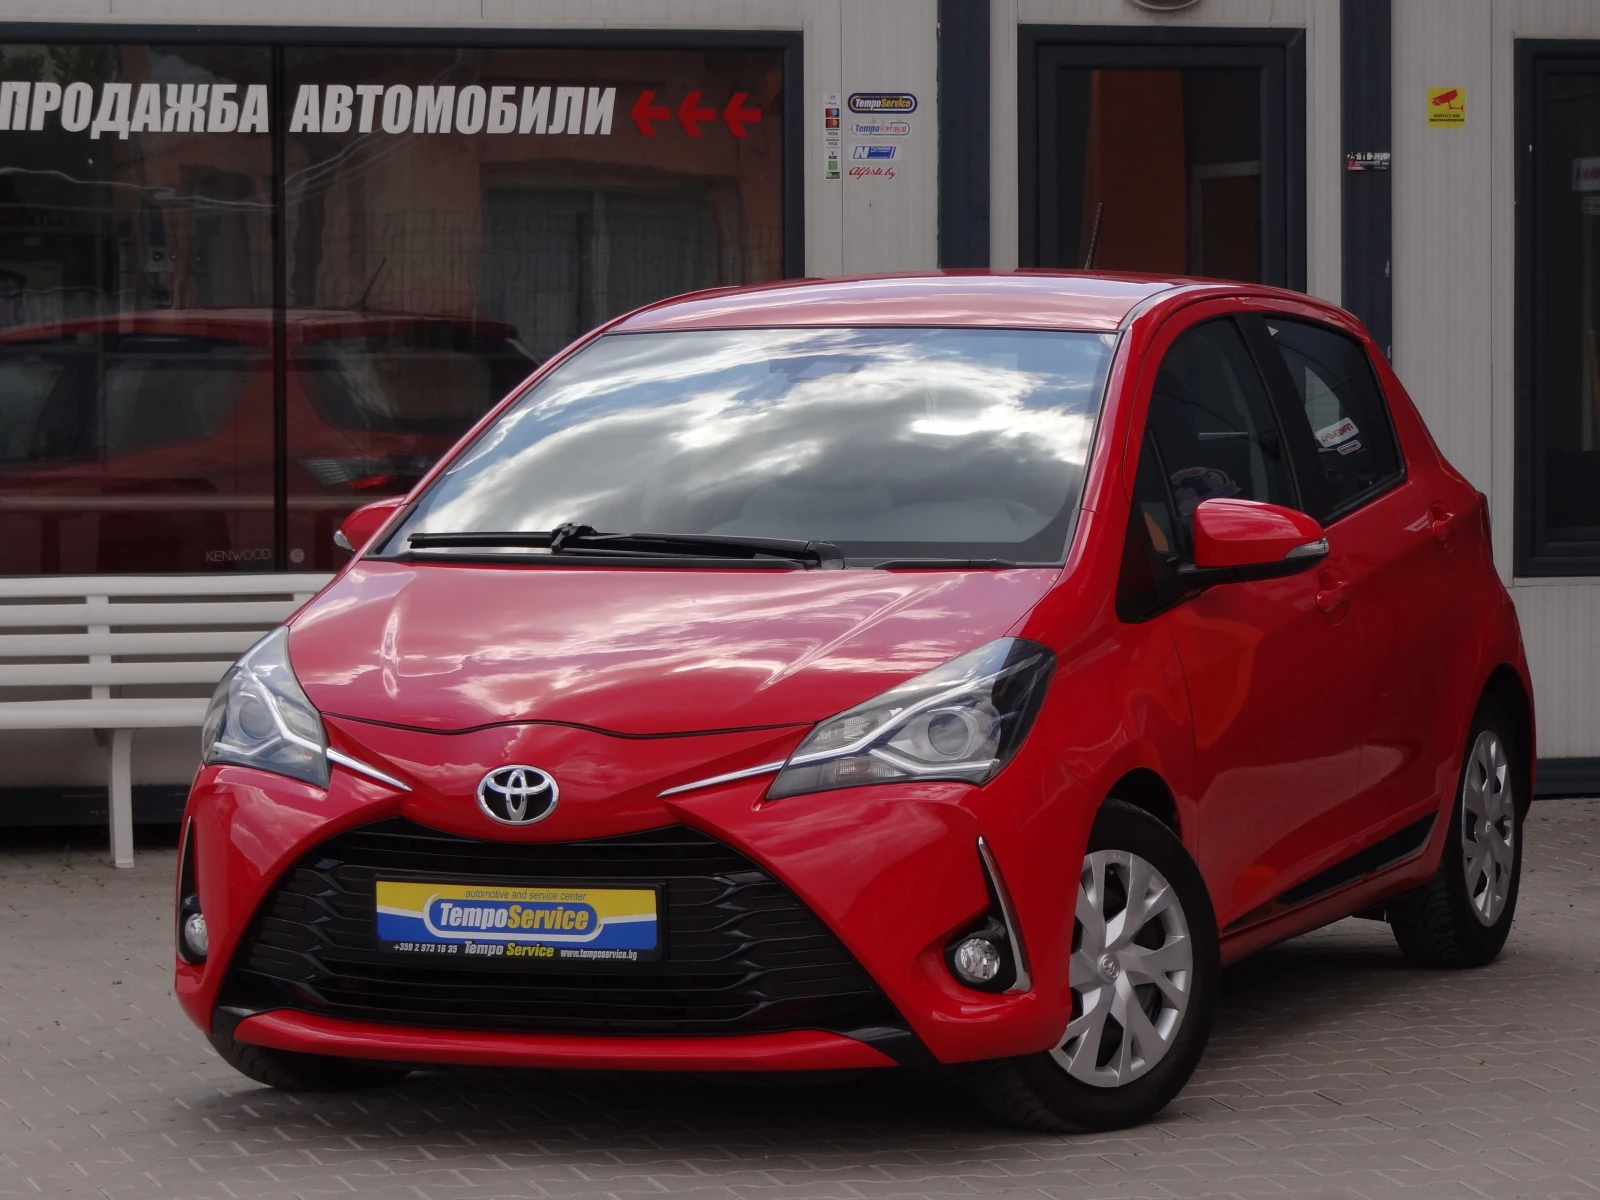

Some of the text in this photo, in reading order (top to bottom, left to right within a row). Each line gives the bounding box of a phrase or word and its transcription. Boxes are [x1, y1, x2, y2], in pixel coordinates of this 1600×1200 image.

[0, 81, 617, 140] ПРОДАЖБА АВТОМОБИЛИ
[855, 98, 911, 111] TempoService
[206, 549, 272, 561] KENWOOD
[465, 889, 587, 901] automotive and service center
[440, 902, 589, 930] TempoService
[393, 942, 458, 954] +359 2 973 16 35
[464, 940, 555, 958] Tempo Service
[560, 949, 638, 961] www.temposervice.bg
